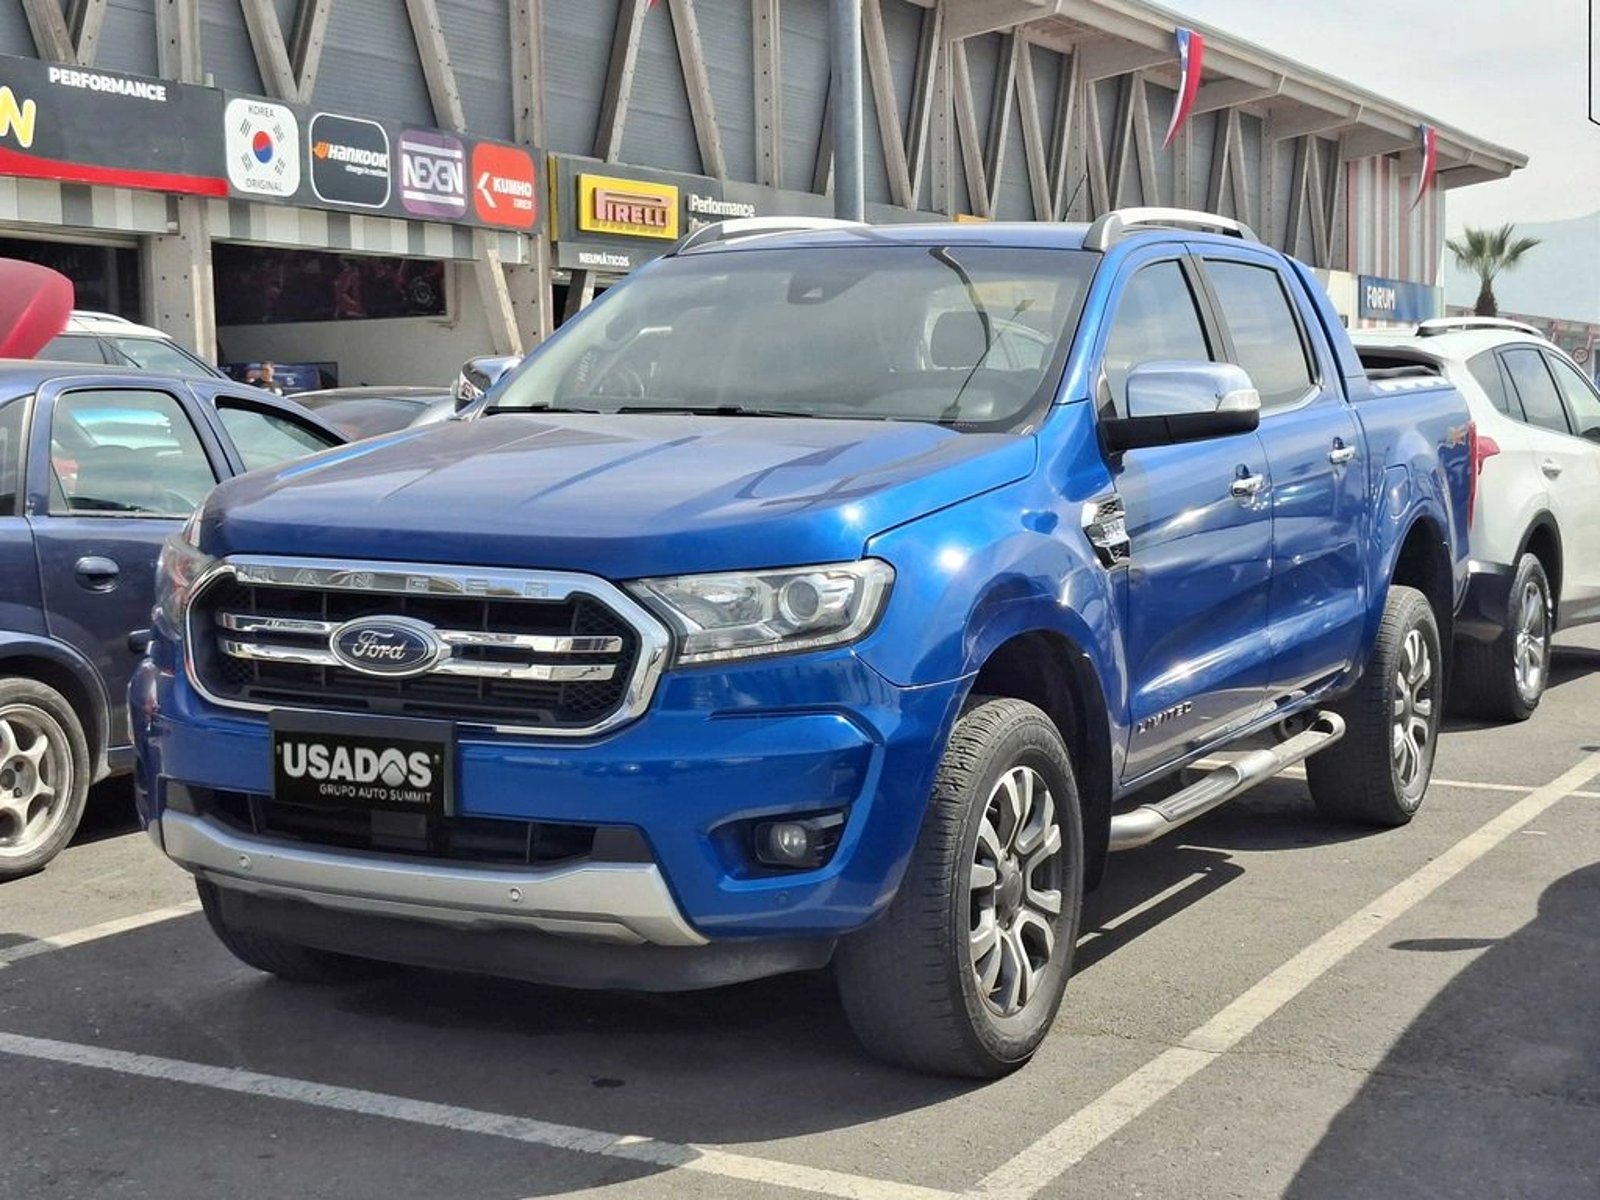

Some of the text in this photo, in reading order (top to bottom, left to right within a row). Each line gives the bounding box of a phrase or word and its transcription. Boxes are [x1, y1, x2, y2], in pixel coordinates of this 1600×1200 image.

[49, 67, 167, 102] PERFORMANCE
[247, 105, 275, 118] KOREA
[245, 177, 283, 192] ORIGINAL
[402, 154, 464, 194] NEXEN
[492, 176, 533, 198] KUMHO
[594, 187, 673, 227] PIRELLI
[688, 193, 755, 217] Performance
[579, 251, 630, 268] NEUMÁTICOS
[1366, 285, 1396, 311] FORUM
[246, 565, 550, 598] RANGER
[352, 630, 406, 660] Ford
[283, 742, 432, 787] USADOS
[319, 782, 432, 803] GRUPO AUTO SUMMIT
